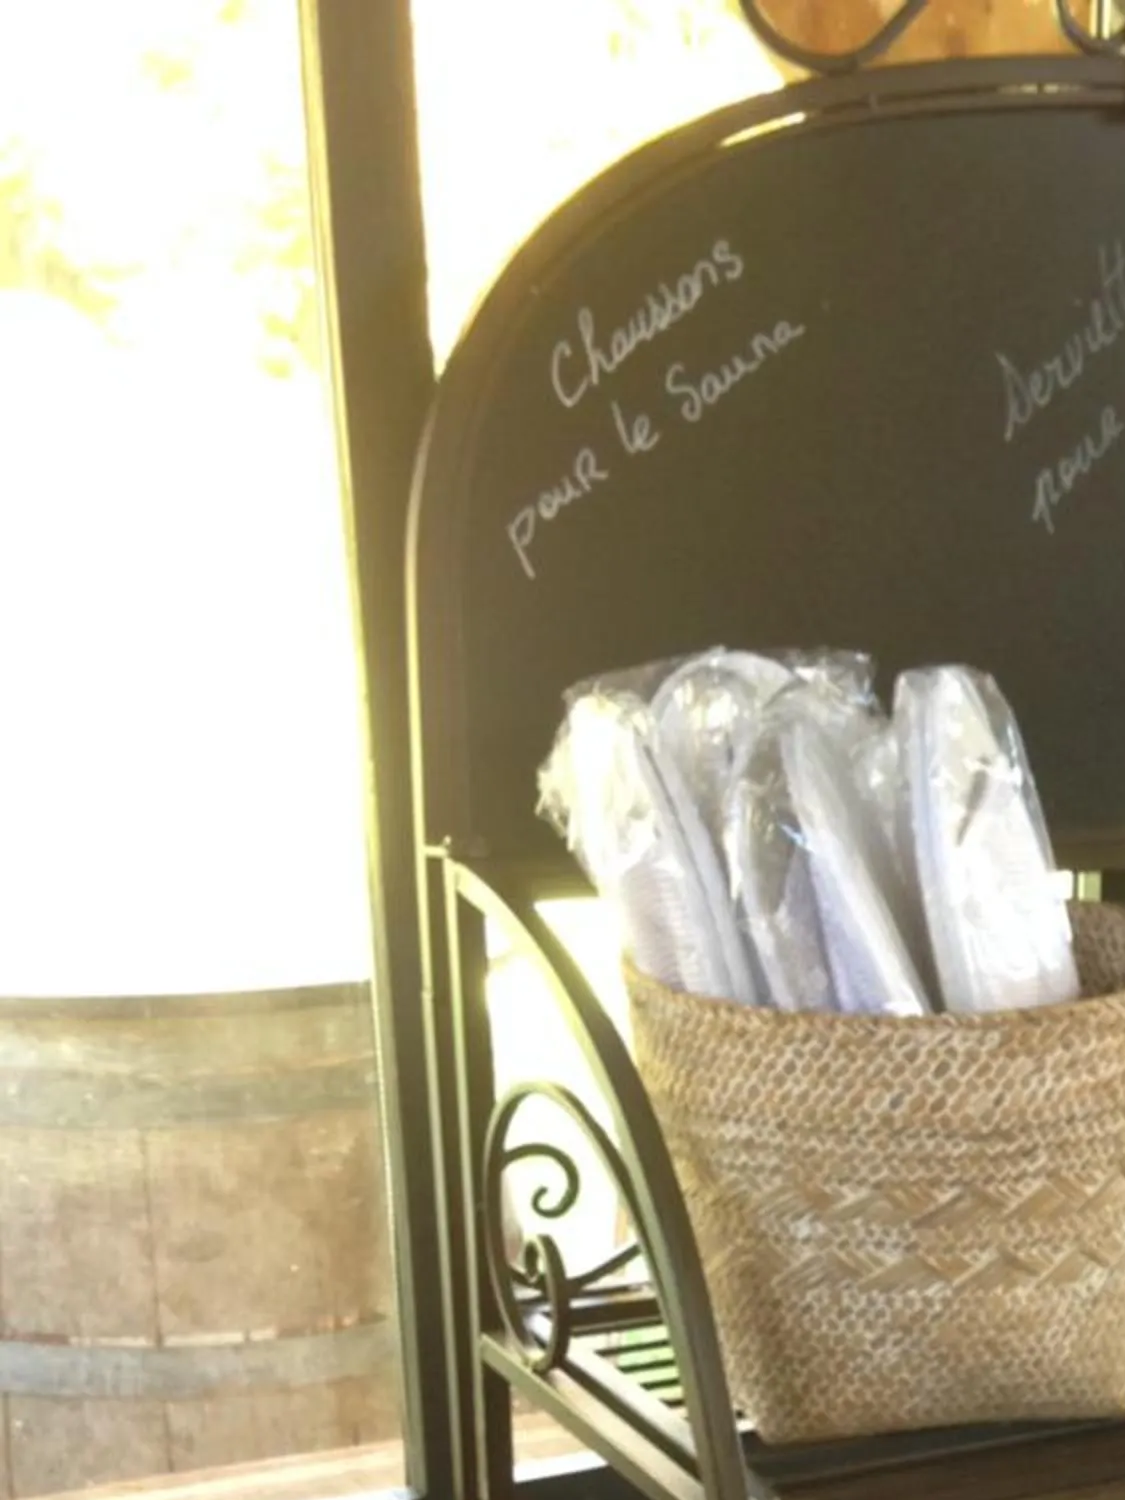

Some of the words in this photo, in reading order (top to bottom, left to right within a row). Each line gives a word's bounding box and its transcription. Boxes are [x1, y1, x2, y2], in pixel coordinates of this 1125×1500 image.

[552, 240, 744, 407] Chaussons
[612, 400, 659, 453] le
[665, 321, 805, 421] Sauna
